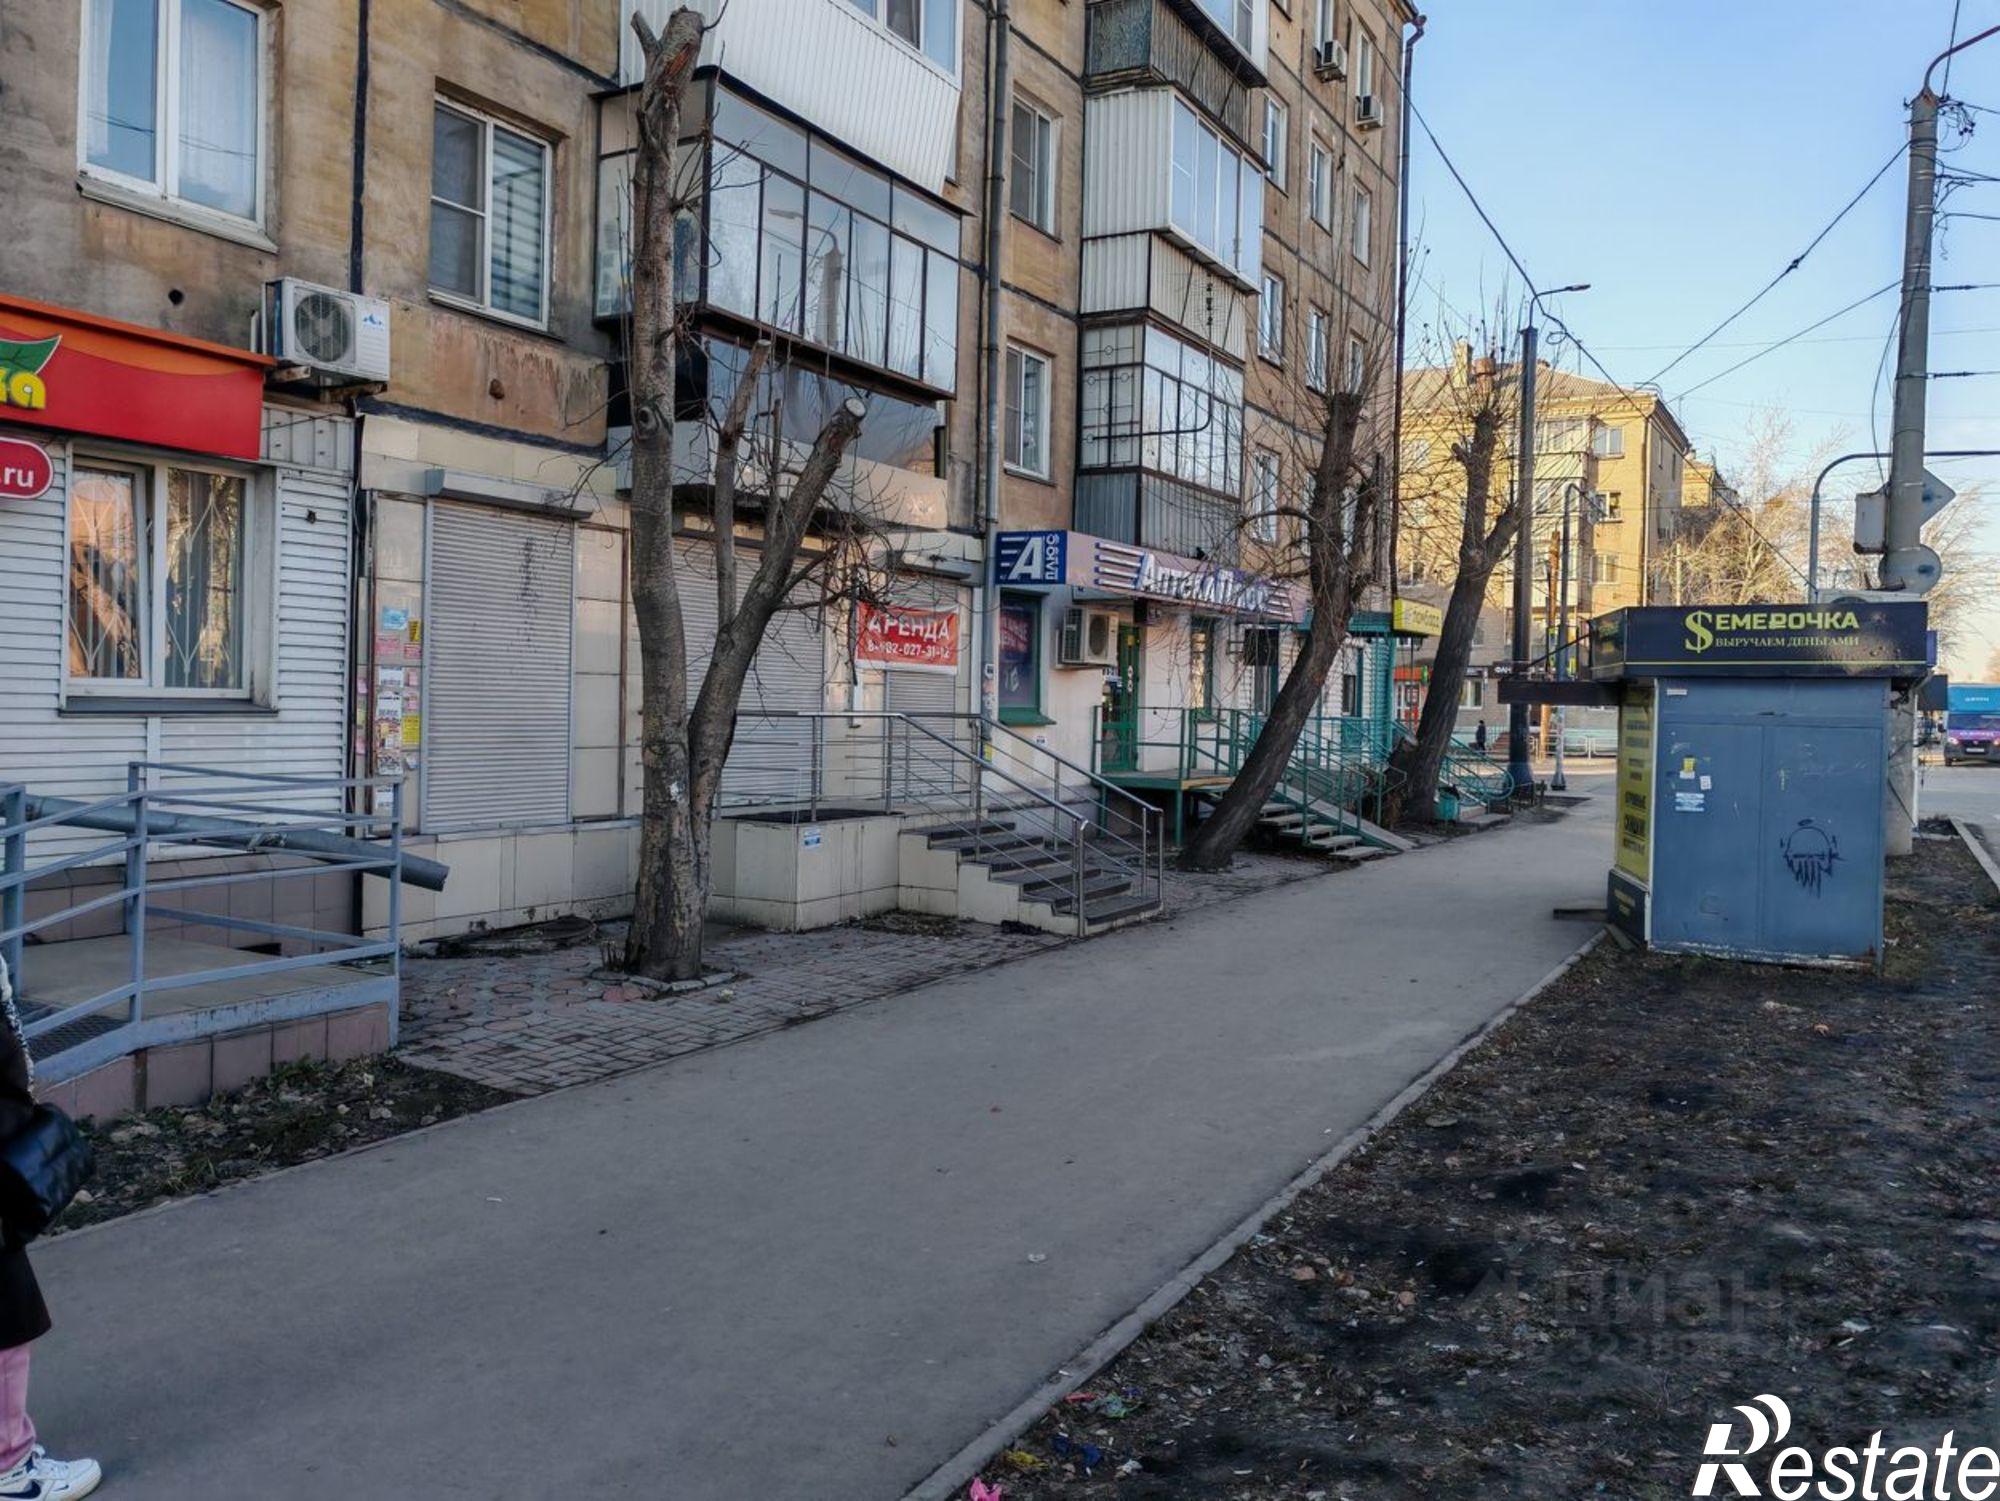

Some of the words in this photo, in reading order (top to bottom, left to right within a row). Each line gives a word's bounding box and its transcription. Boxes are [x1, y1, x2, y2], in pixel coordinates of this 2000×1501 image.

[867, 611, 951, 643] АРЕНДА
[1715, 636, 1785, 647] ВЫРУЧАЕМ
[1787, 635, 1859, 648] ДЕНЬГАМИ
